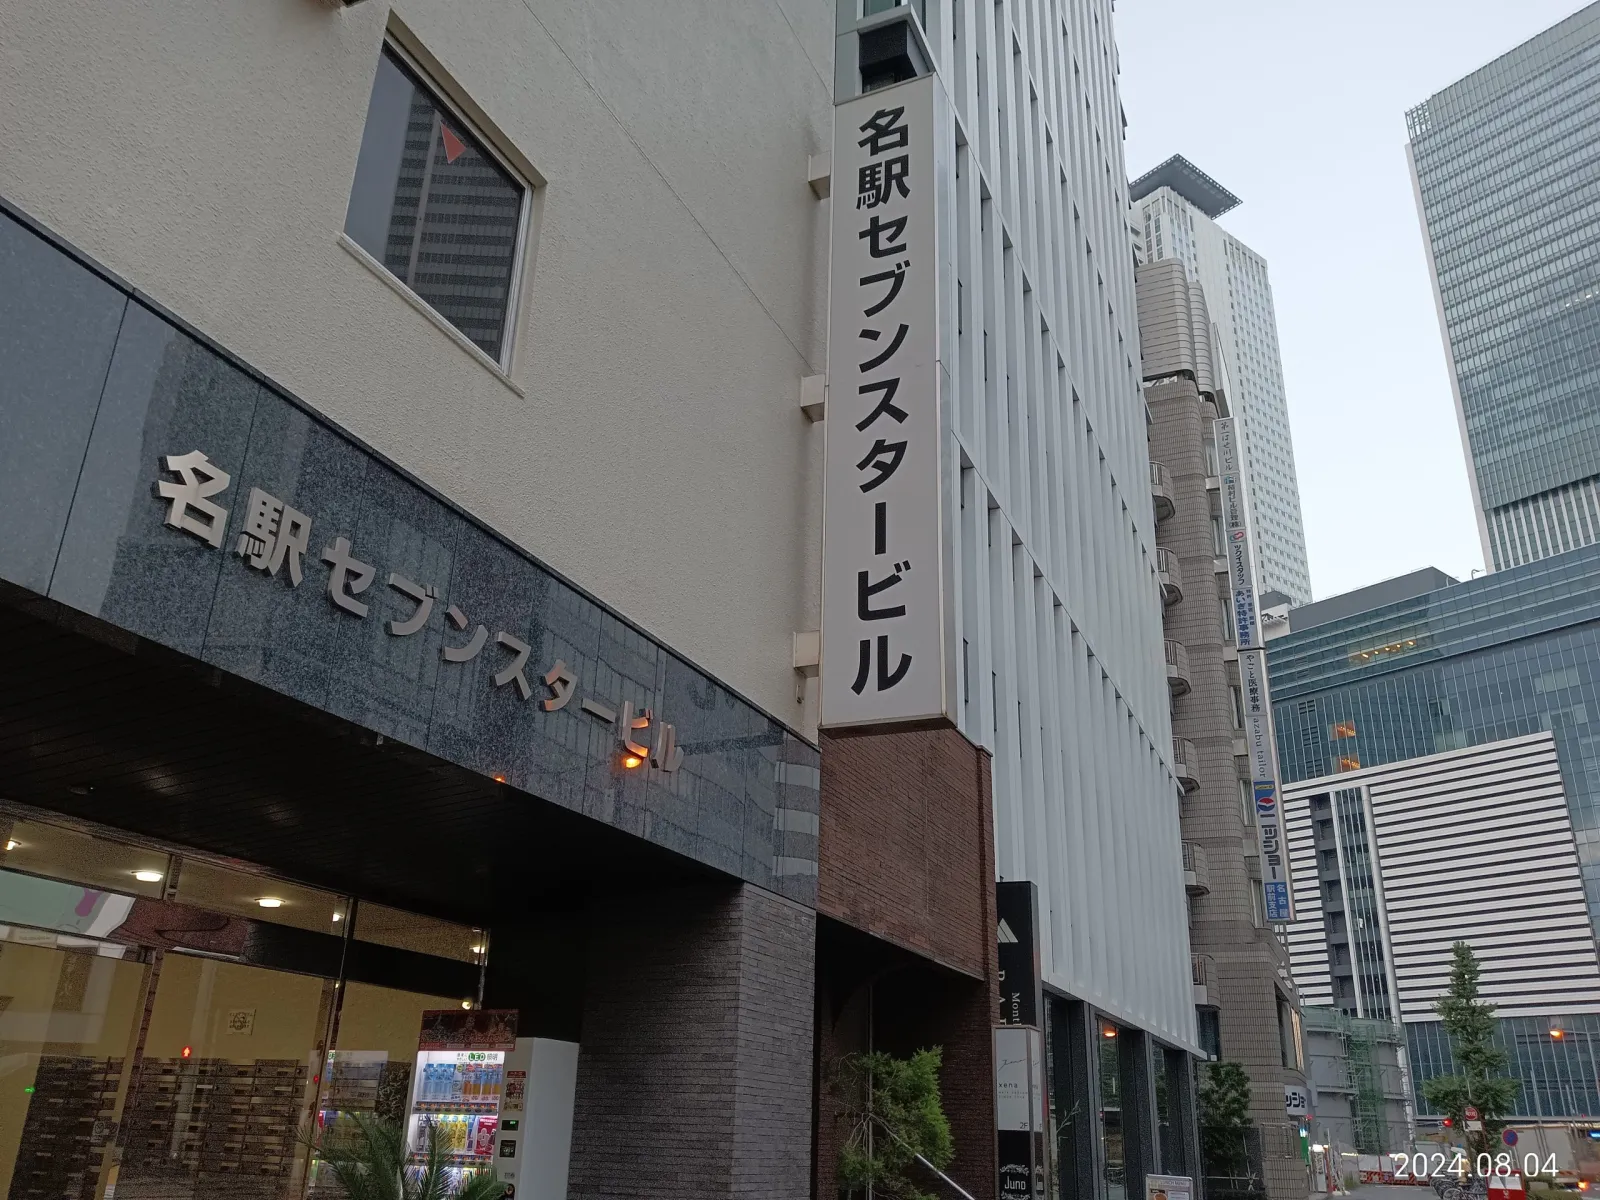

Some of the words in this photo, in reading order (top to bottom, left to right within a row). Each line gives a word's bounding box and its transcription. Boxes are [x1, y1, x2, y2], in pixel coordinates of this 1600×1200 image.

[850, 106, 912, 696] 名駅セブンスタービル
[152, 449, 685, 772] 名駅セブンスタービル
[1252, 717, 1264, 747] azabu
[1256, 750, 1268, 778] tailor
[1265, 884, 1278, 918] 駅前支店
[468, 1052, 486, 1061] LED
[1019, 1121, 1029, 1130] 2F
[1004, 1175, 1027, 1190] Juno
